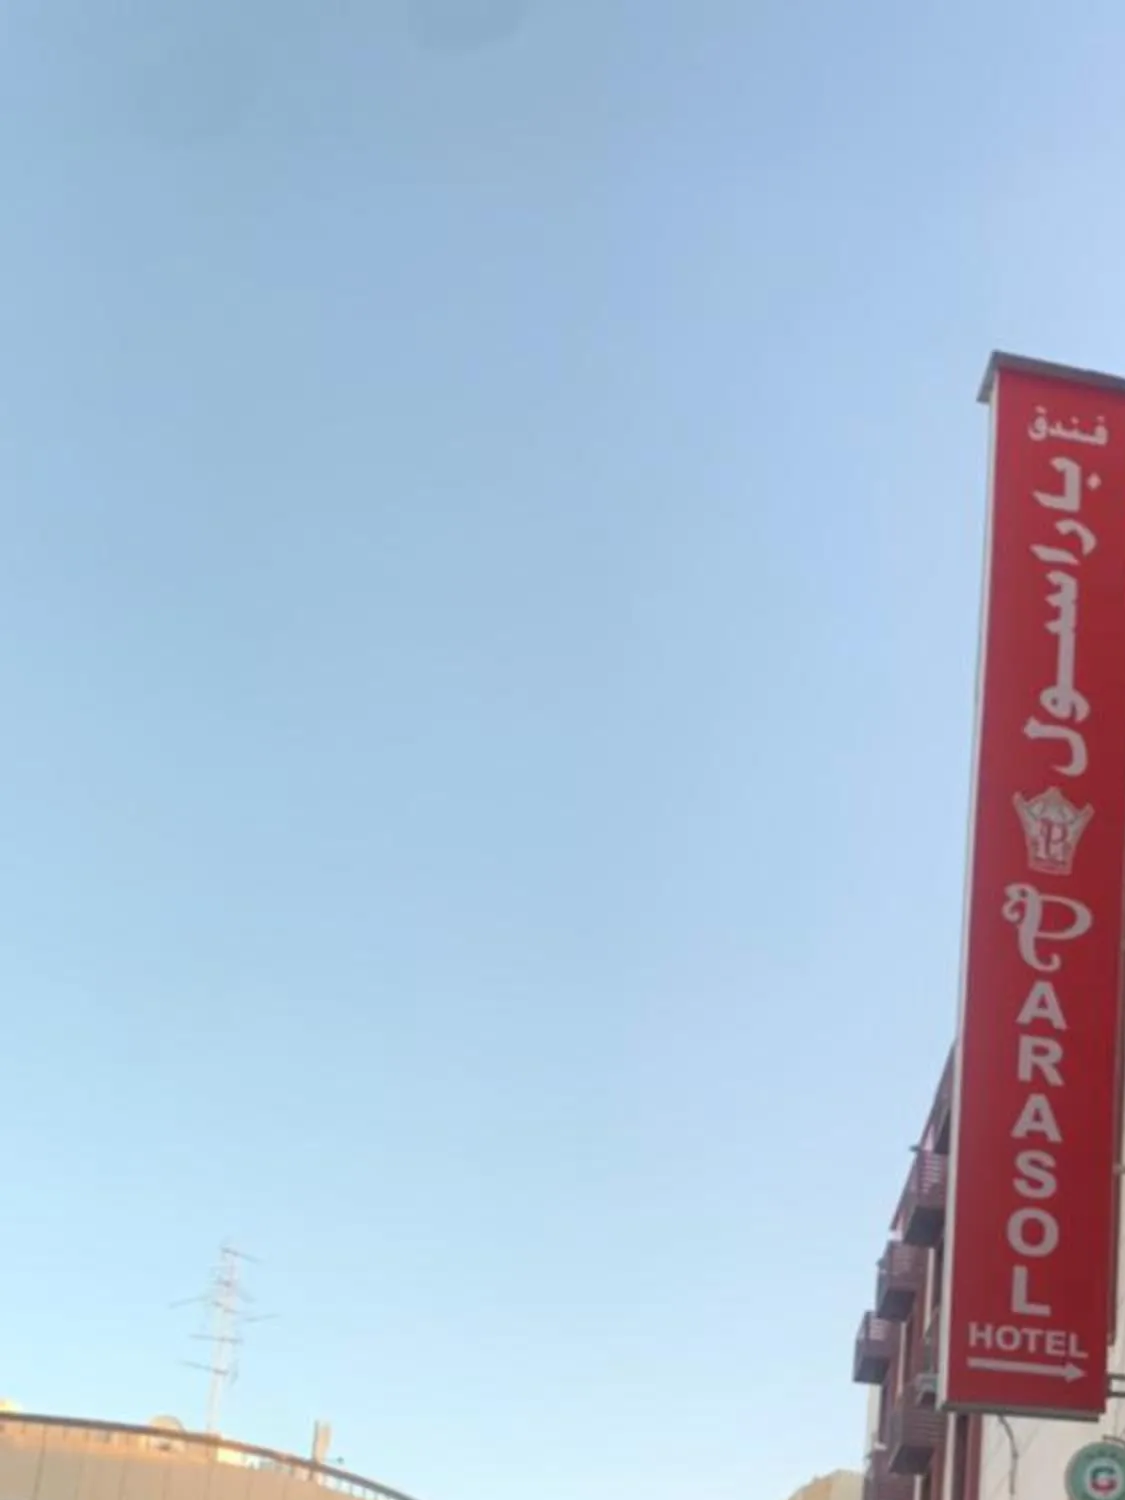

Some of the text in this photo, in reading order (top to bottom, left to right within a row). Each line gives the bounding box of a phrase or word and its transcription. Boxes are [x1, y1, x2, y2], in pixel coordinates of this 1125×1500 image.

[1028, 405, 1108, 446] فندق
[1022, 455, 1102, 777] باراسول
[1002, 883, 1094, 1317] PARASOL
[967, 1322, 1089, 1360] HOTEL
